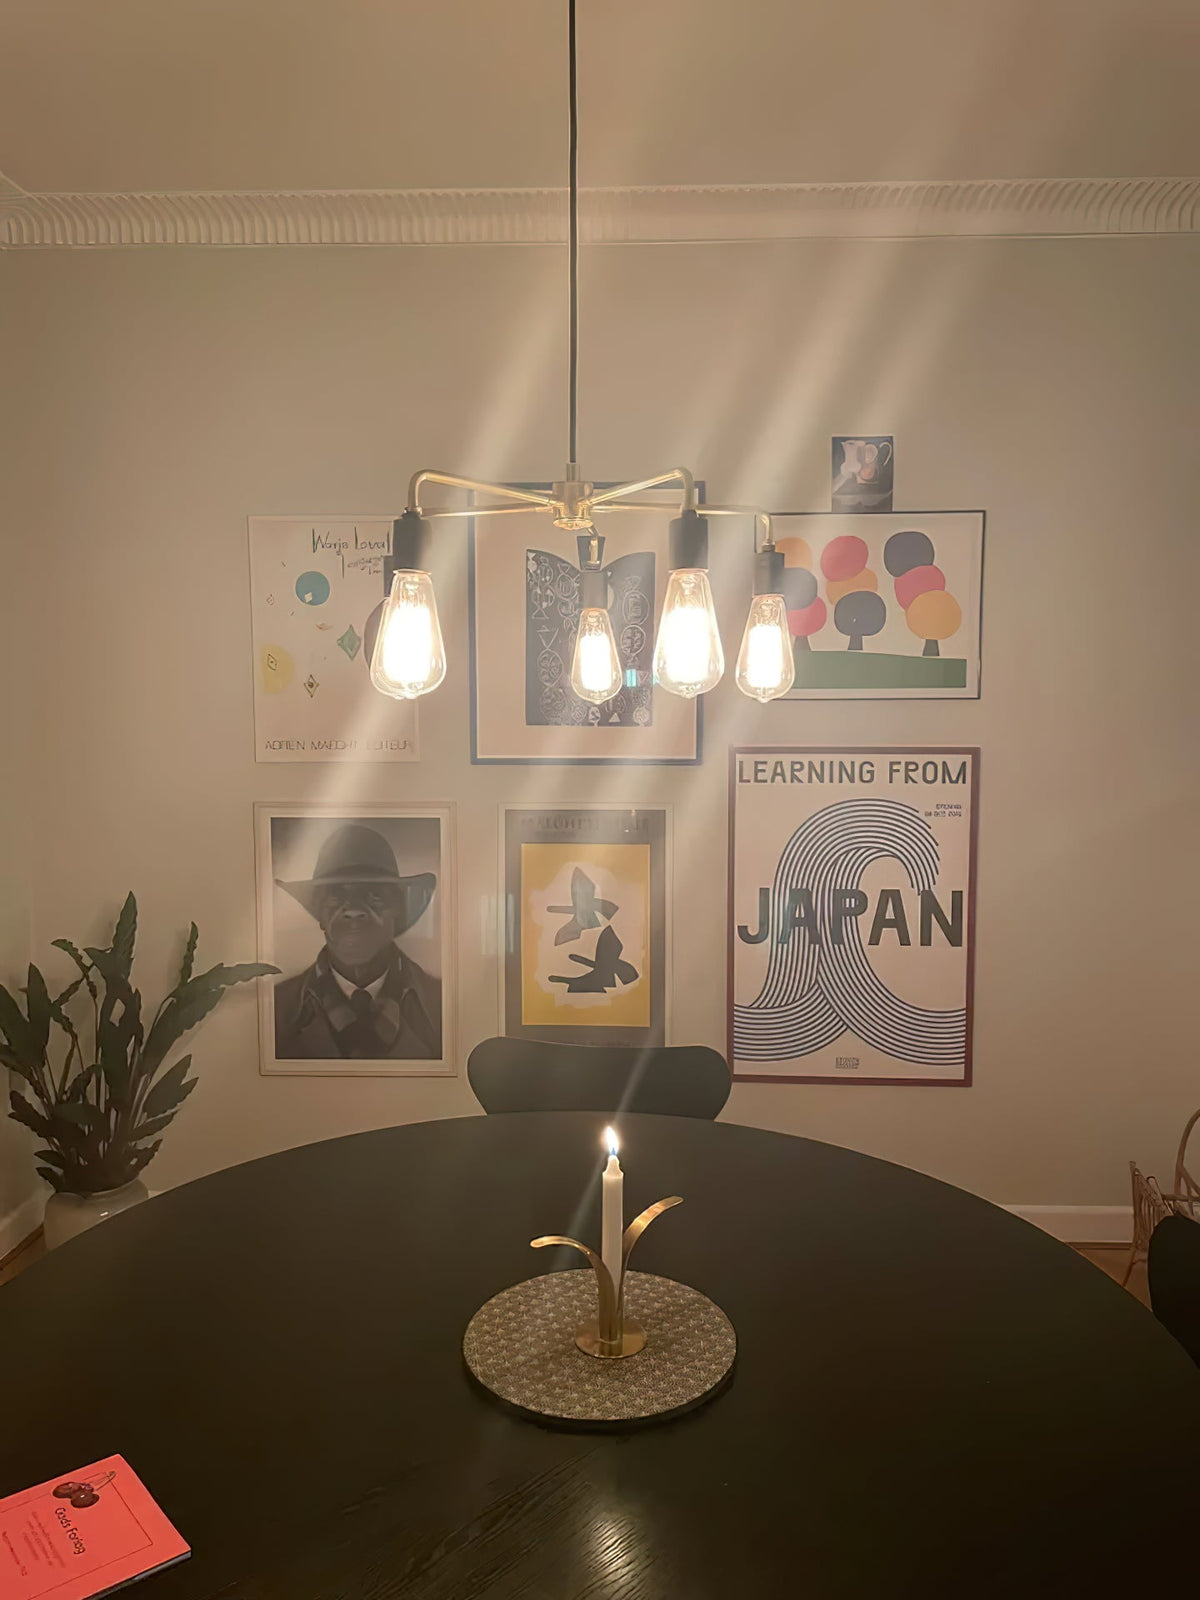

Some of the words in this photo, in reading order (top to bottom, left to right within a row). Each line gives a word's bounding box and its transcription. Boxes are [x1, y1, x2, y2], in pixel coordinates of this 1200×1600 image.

[738, 760, 876, 784] LEARNING
[888, 760, 967, 785] FROM
[737, 887, 963, 947] JAPAN
